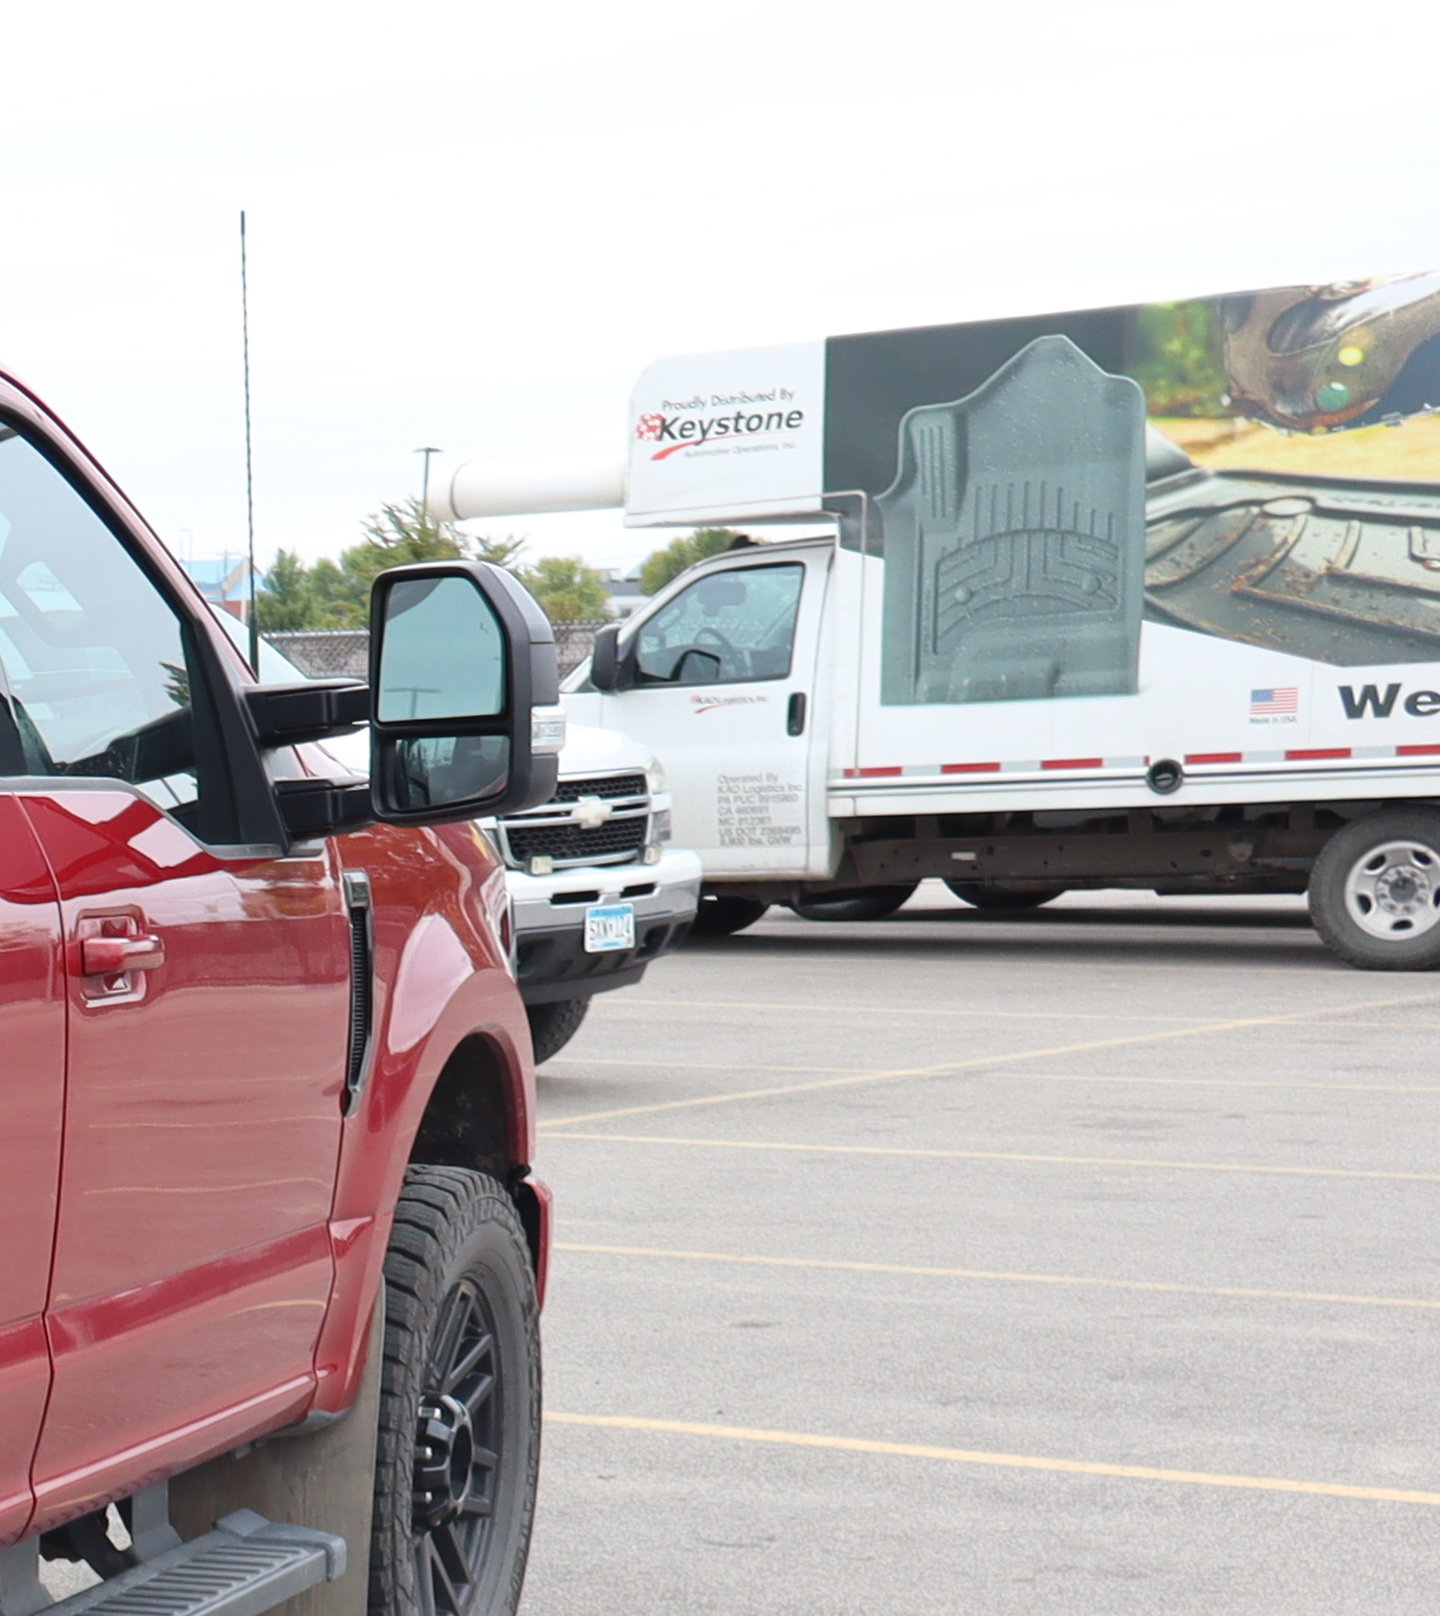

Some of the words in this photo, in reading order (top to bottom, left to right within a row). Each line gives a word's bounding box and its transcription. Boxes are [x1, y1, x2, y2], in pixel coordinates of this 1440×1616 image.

[662, 395, 706, 411] Proudly
[711, 389, 776, 407] Distributed
[780, 388, 795, 402] By
[658, 409, 803, 446] Keystone
